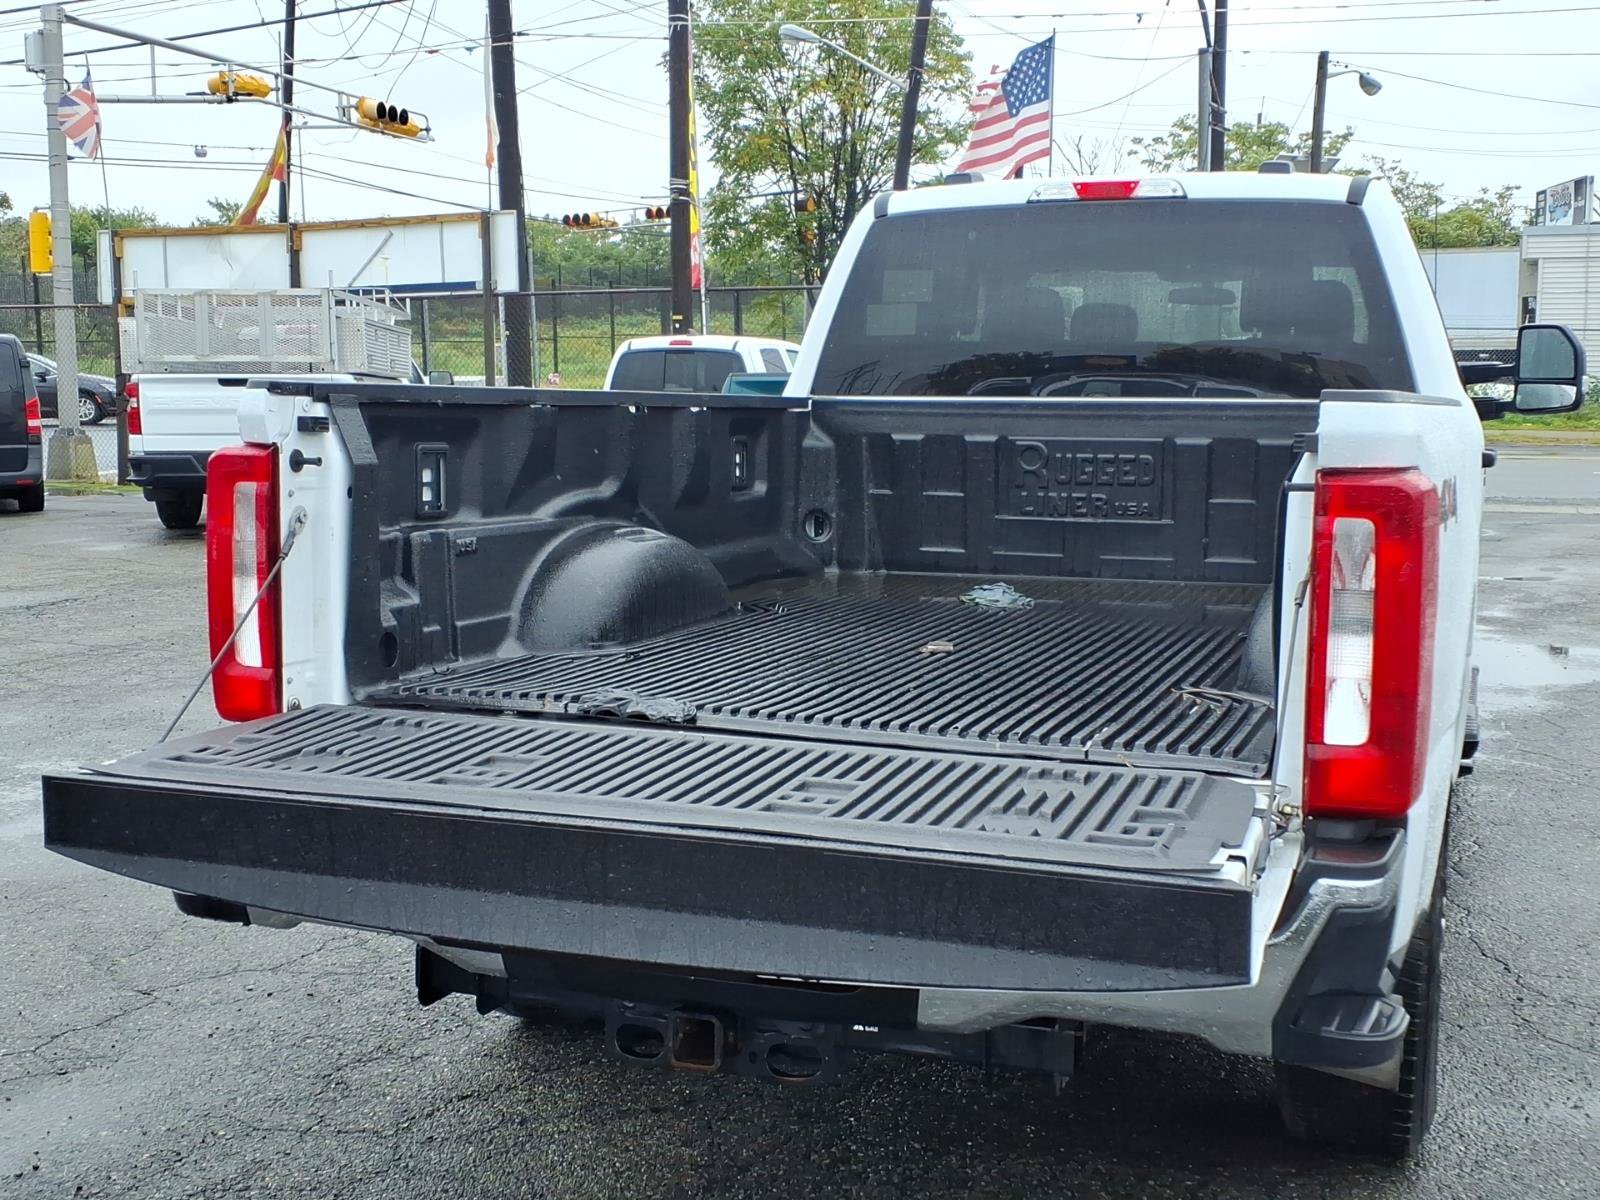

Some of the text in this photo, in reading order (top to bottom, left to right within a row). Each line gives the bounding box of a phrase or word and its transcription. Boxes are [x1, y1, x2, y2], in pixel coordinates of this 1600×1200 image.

[1014, 441, 1154, 489] RUGGED
[1019, 492, 1152, 516] LINER USA
